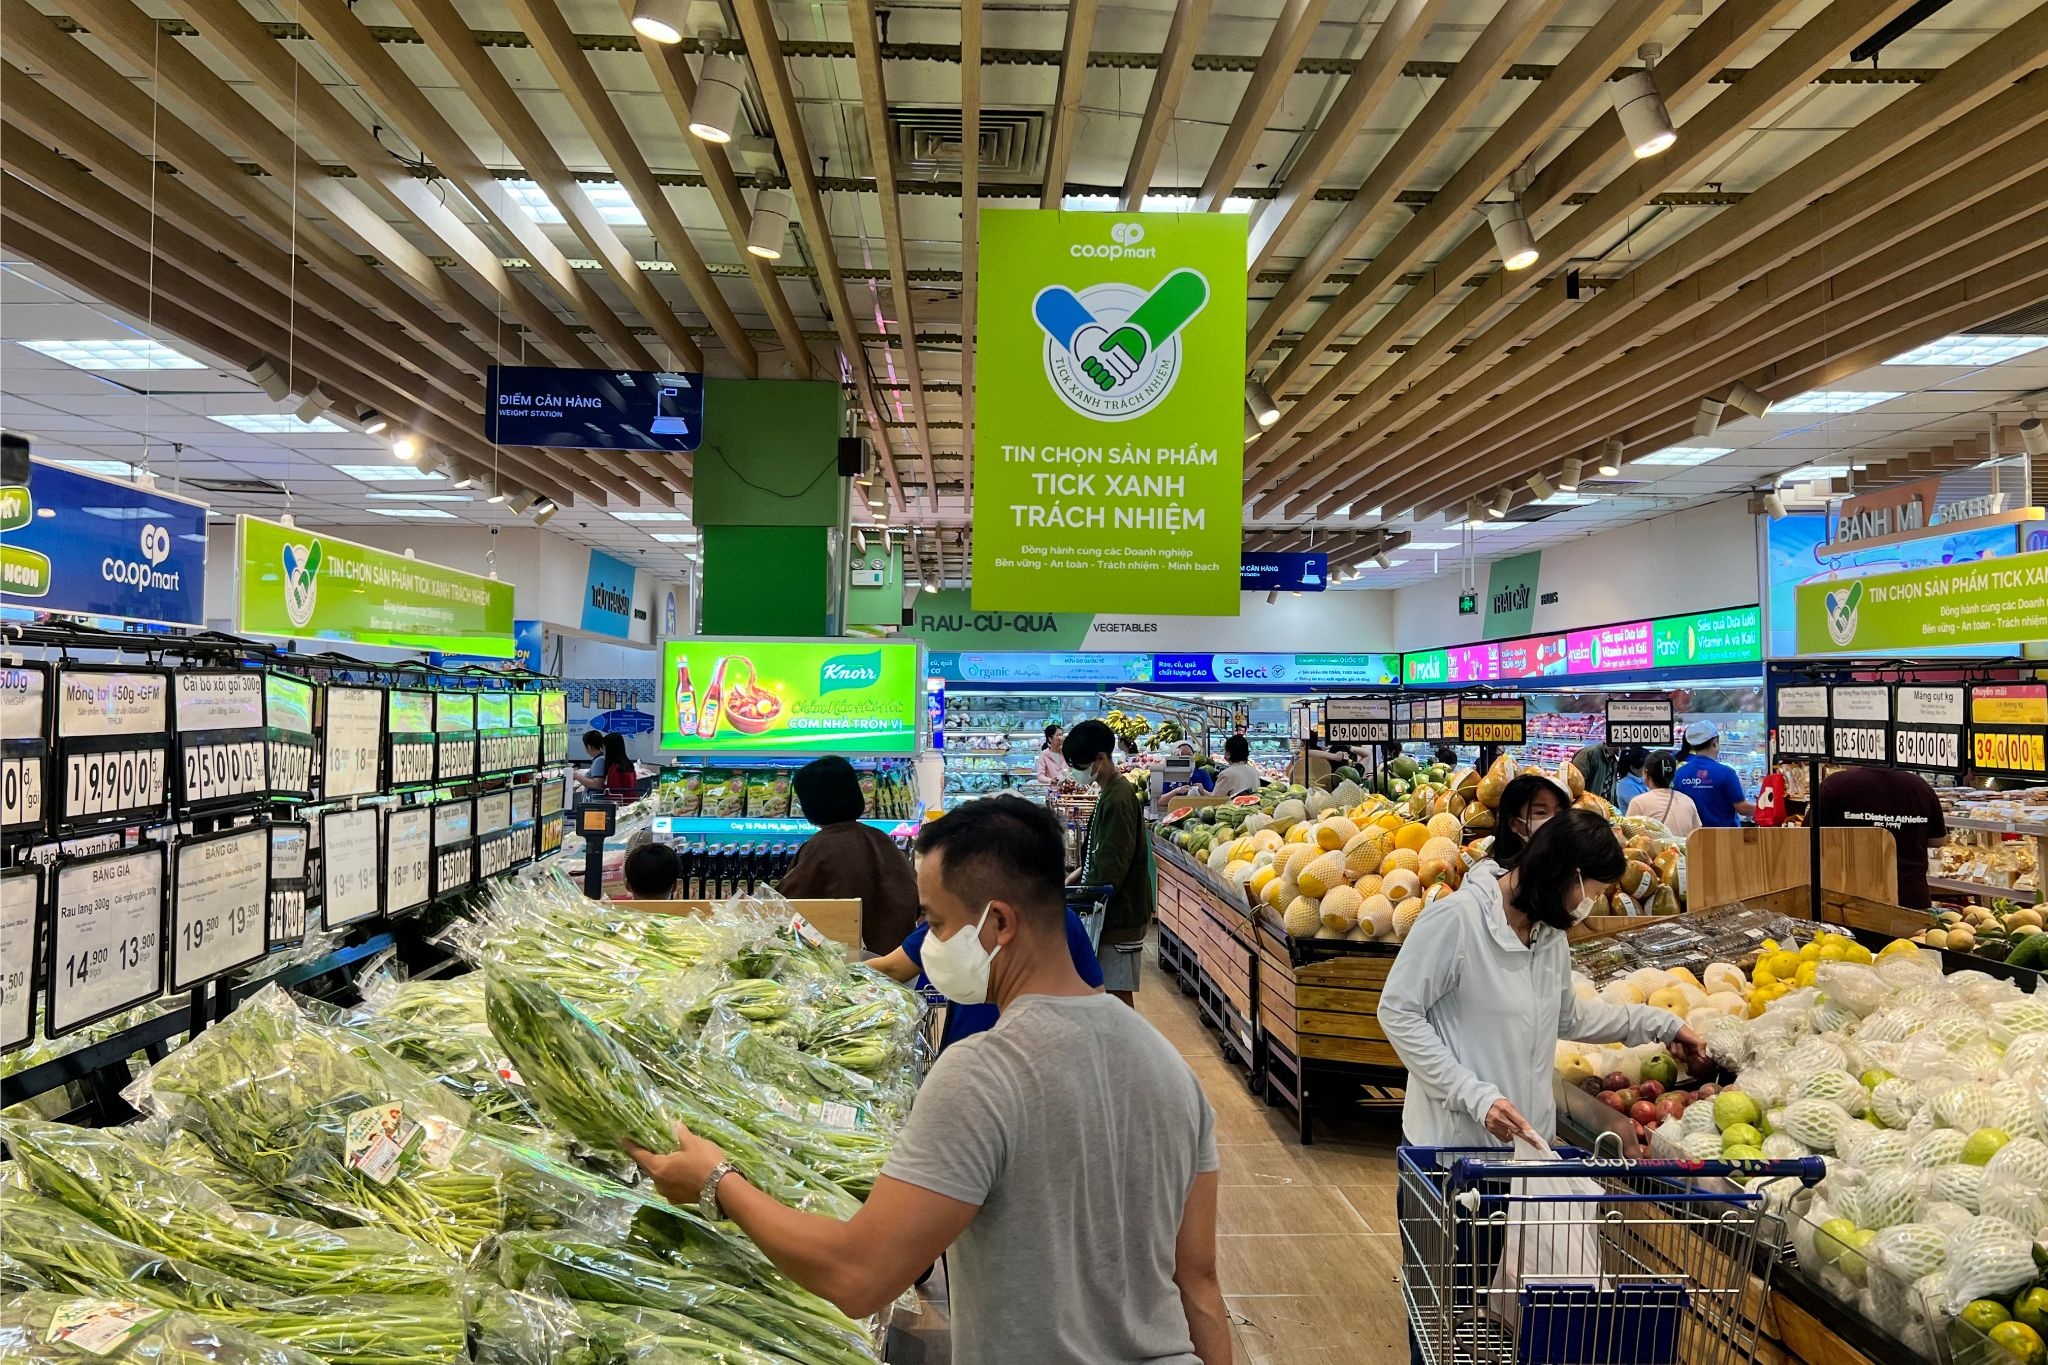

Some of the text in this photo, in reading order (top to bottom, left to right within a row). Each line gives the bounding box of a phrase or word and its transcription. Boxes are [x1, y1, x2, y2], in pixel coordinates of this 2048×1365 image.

[1055, 357, 1171, 410] TICK XANH TRÁCH NHIỆM
[500, 392, 602, 408] ĐIỂM CÂN HÀNG
[499, 409, 562, 418] WEIGHT STATION
[1001, 442, 1217, 467] TIN CHỌN SẢN PHẨM
[1032, 473, 1185, 497] TICK XANH
[1010, 500, 1205, 535] TRÁCH NHIỆM
[1838, 493, 2004, 543] BÁNH MÌ BAKERY
[1021, 545, 1193, 558] Đồng hành cùng các Doanh nghiệp
[995, 558, 1220, 573] Bền vững An toàn Trách nhiệm Minh bạch
[4, 563, 39, 587] NGON
[327, 555, 343, 578] TIN
[345, 560, 372, 587] CHỌN
[373, 561, 390, 587] SẢN
[391, 566, 413, 593] PHẨM
[414, 575, 430, 595] TICK
[431, 580, 451, 599] XANH
[1869, 568, 2022, 604] TIN CHỌN SẢN PHẨM TICK
[1940, 605, 1959, 618] Đồng
[1960, 603, 1980, 615] hành
[2002, 601, 2016, 611] các
[2018, 596, 2044, 609] Doanh
[1093, 623, 1158, 632] VEGETABLES
[1973, 619, 1990, 631] toàn
[1997, 616, 2020, 628] Trách
[823, 664, 877, 680] Knorr
[968, 664, 1010, 679] Organic
[1223, 664, 1267, 678] Select
[242, 676, 261, 694] 300g
[1972, 688, 1994, 698] Khuyến
[112, 685, 134, 704] 450g
[1945, 690, 1954, 703] kg
[822, 715, 851, 729] NHÀ
[852, 715, 888, 729] TRÒN
[1332, 727, 1377, 738] 69.000
[1465, 726, 1511, 738] 34.900
[1613, 727, 1659, 739] 25.000
[1780, 729, 1815, 748] 51.500
[1835, 732, 1874, 754] 23.500
[1898, 734, 1946, 758] 89.000
[1976, 738, 2030, 763] 39.000
[187, 749, 253, 788] 25.000
[73, 758, 148, 801] 19.900
[1844, 811, 1928, 823] East District Athletics
[92, 867, 115, 883] BẢNG
[61, 907, 76, 919] Rau
[77, 902, 93, 915] lang
